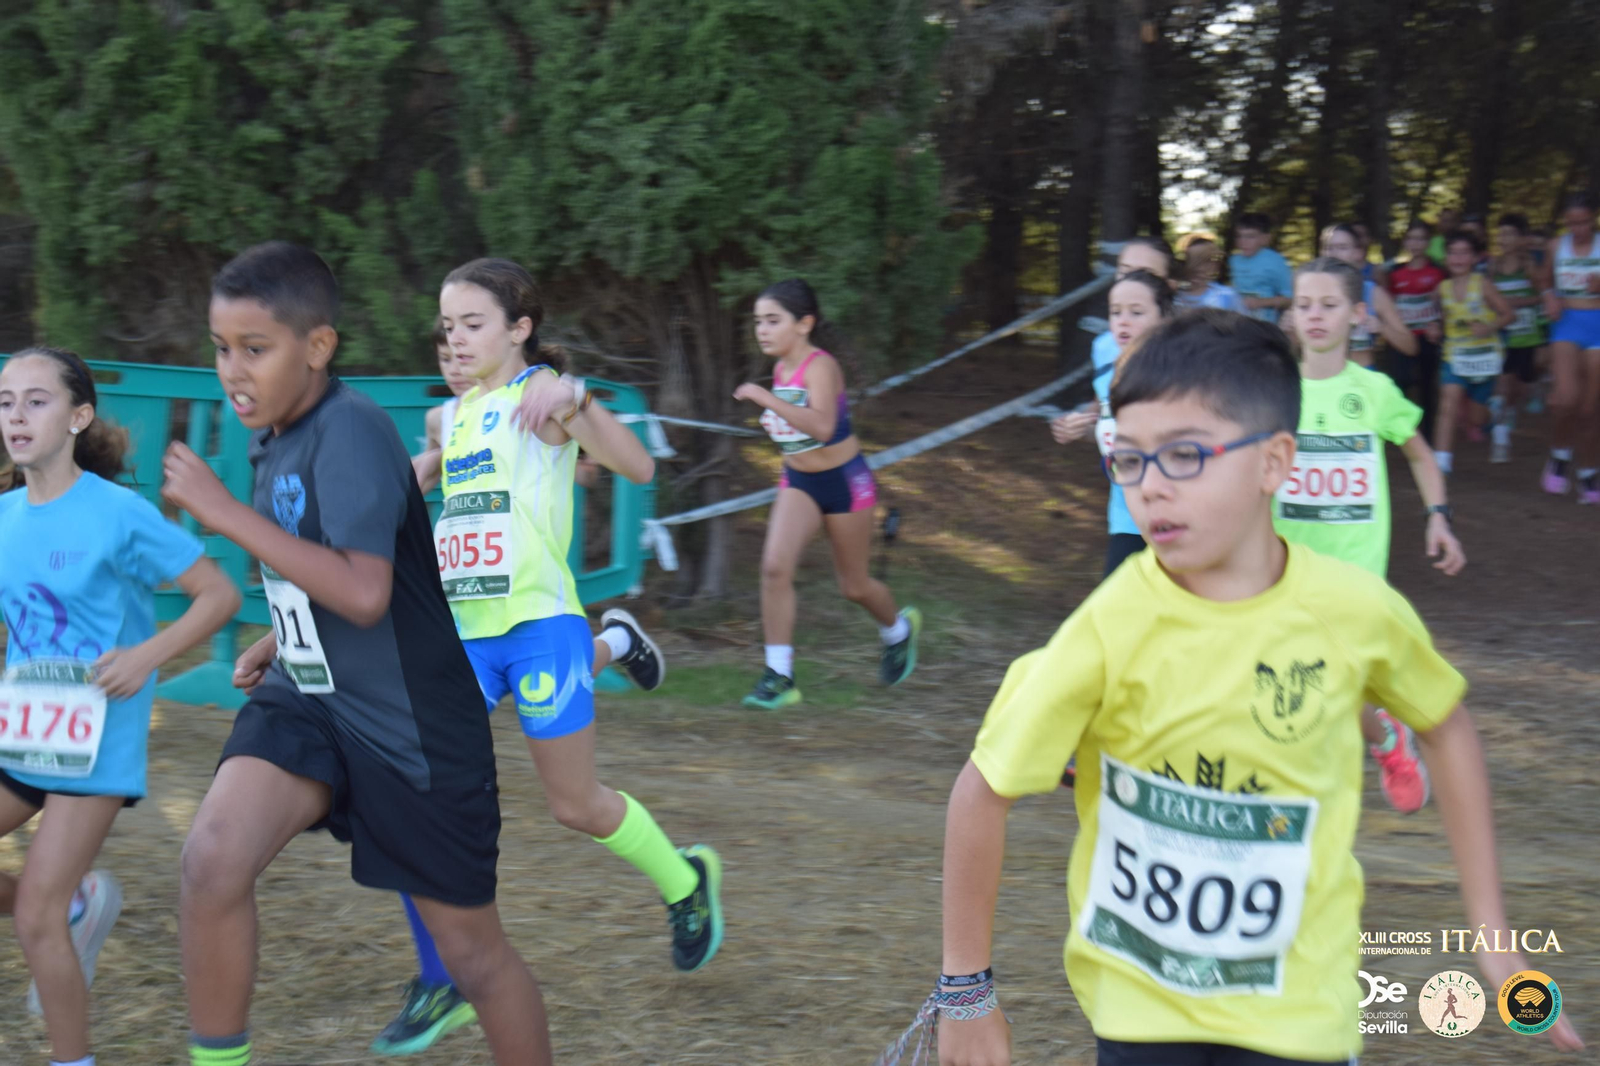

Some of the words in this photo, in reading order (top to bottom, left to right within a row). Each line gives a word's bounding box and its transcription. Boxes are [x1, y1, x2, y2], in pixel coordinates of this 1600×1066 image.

[1286, 466, 1369, 497] 5003
[438, 531, 504, 572] 5055
[1111, 836, 1283, 941] 5809
